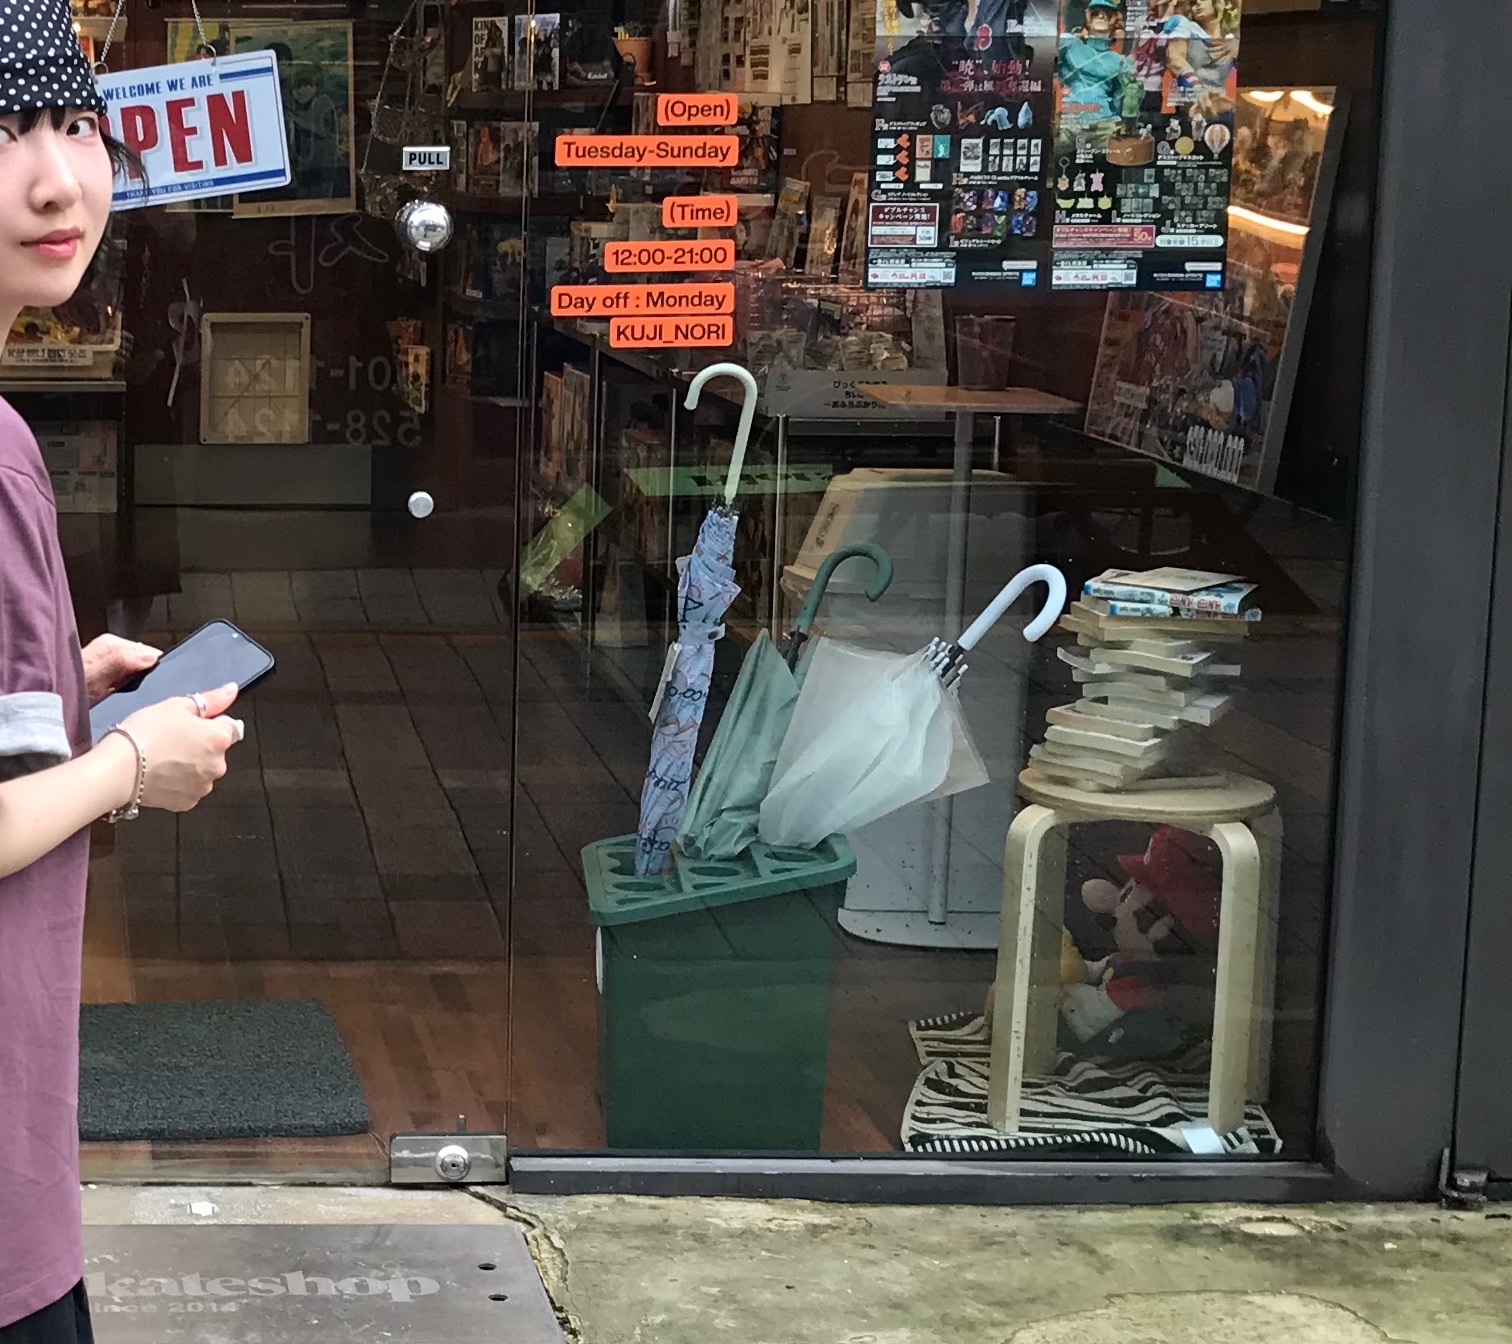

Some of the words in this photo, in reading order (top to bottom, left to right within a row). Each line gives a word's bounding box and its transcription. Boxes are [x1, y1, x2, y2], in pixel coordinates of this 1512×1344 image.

[102, 81, 163, 102] WELCOME
[167, 78, 186, 93] WE
[191, 74, 214, 90] ARE
[664, 98, 731, 121] (Open)
[98, 90, 254, 181] PEN
[407, 151, 444, 166] PULL
[563, 140, 731, 162] Tuesday-Sunday
[670, 201, 731, 223] (Time)
[612, 246, 728, 266] 12:00-21:00
[557, 291, 596, 310] Day
[601, 291, 630, 309] off
[645, 289, 727, 309] Monday
[616, 323, 726, 343] KUJI_NORI
[91, 1270, 442, 1303] kateshop
[94, 1301, 158, 1314] ince
